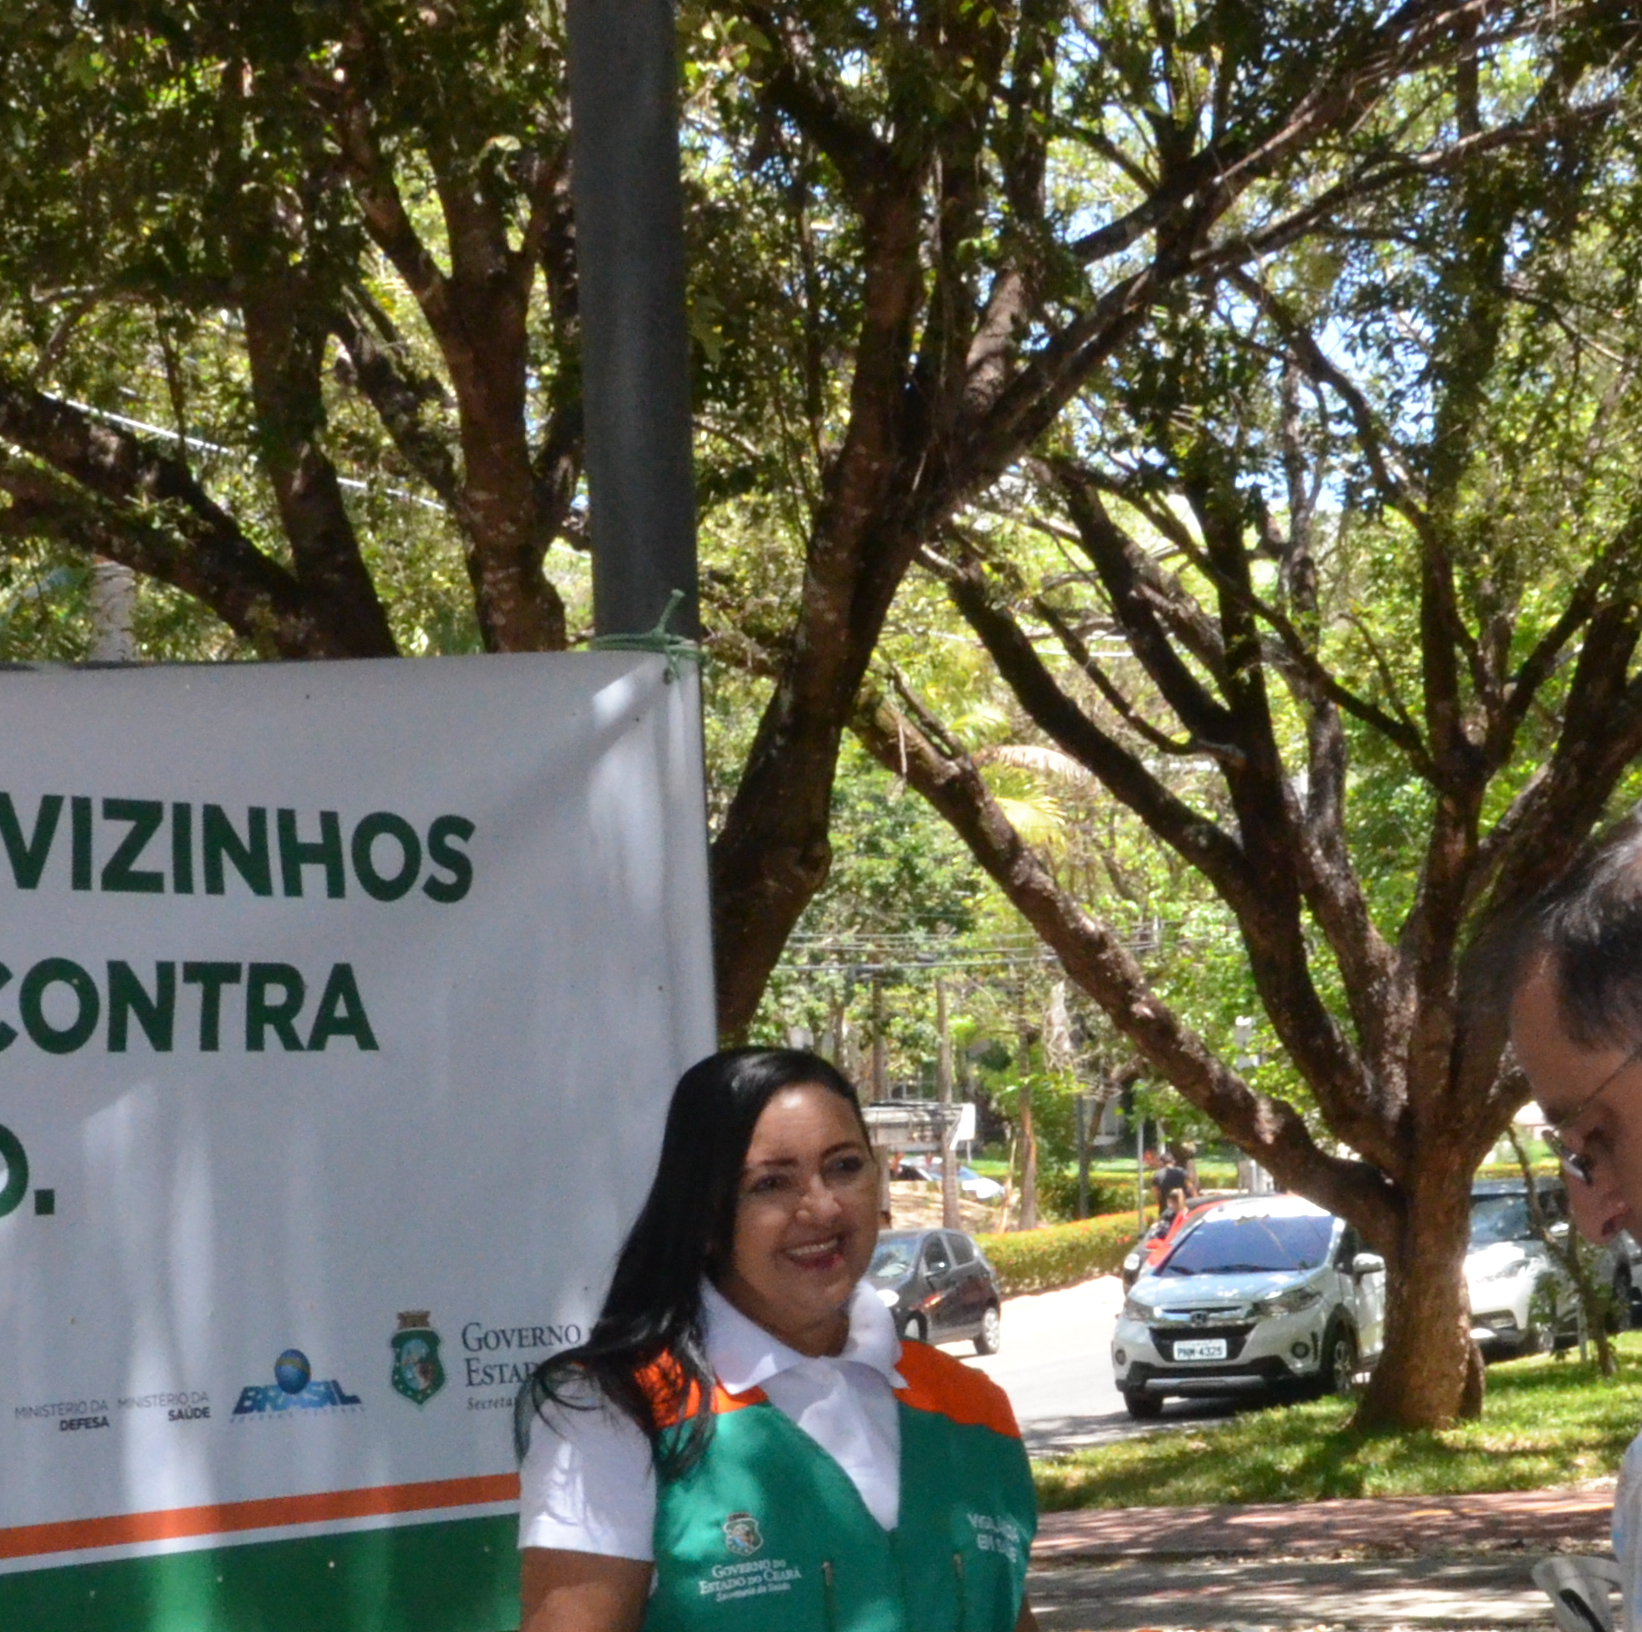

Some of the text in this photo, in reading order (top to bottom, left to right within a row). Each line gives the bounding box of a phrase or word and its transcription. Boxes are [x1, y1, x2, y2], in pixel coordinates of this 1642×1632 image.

[461, 1321, 582, 1352] GOVERNO
[168, 1405, 212, 1422] SAÚDE
[59, 1415, 110, 1432] DEFESA
[711, 1559, 771, 1579] GOVERNO
[698, 1577, 747, 1595] ESTADO
